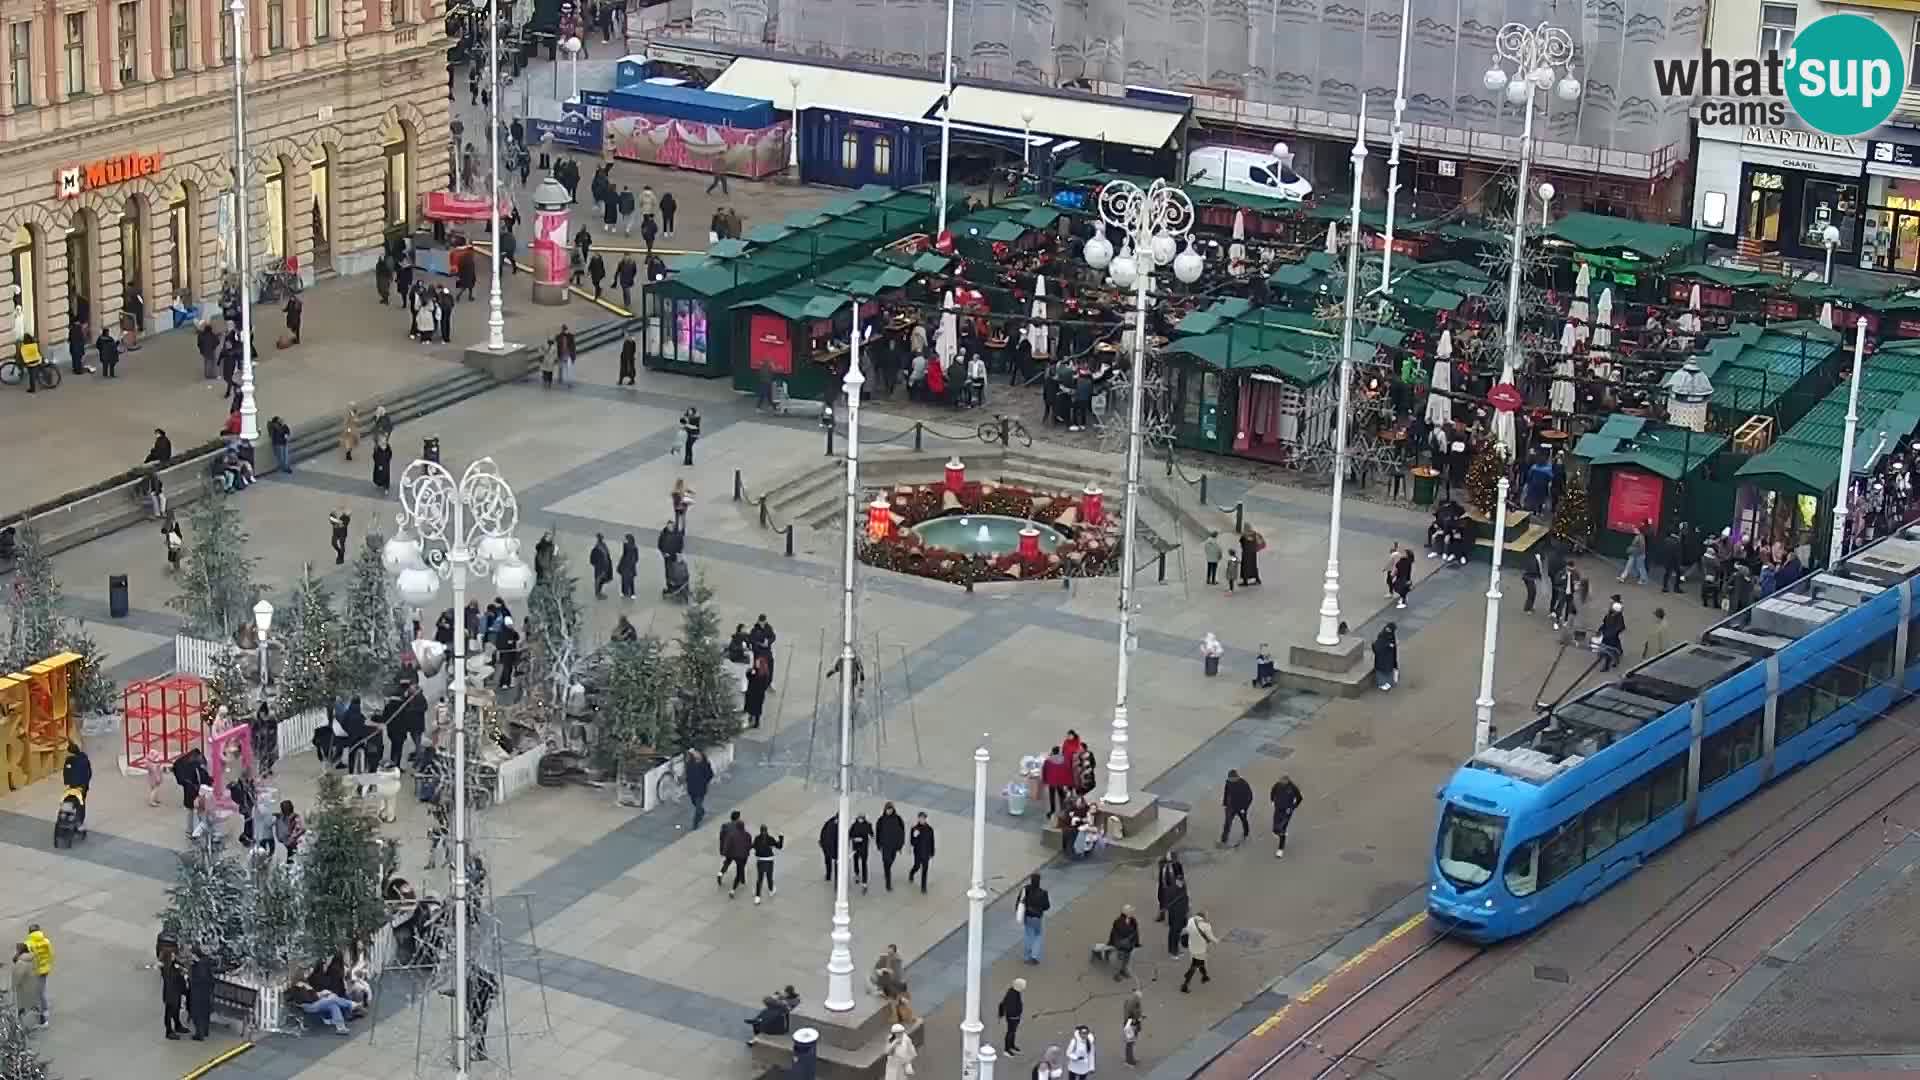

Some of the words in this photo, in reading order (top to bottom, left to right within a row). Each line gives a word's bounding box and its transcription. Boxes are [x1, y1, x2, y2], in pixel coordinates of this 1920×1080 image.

[1746, 126, 1857, 154] MARTIMEX
[85, 151, 162, 189] Müller
[1782, 159, 1820, 170] CHANEL
